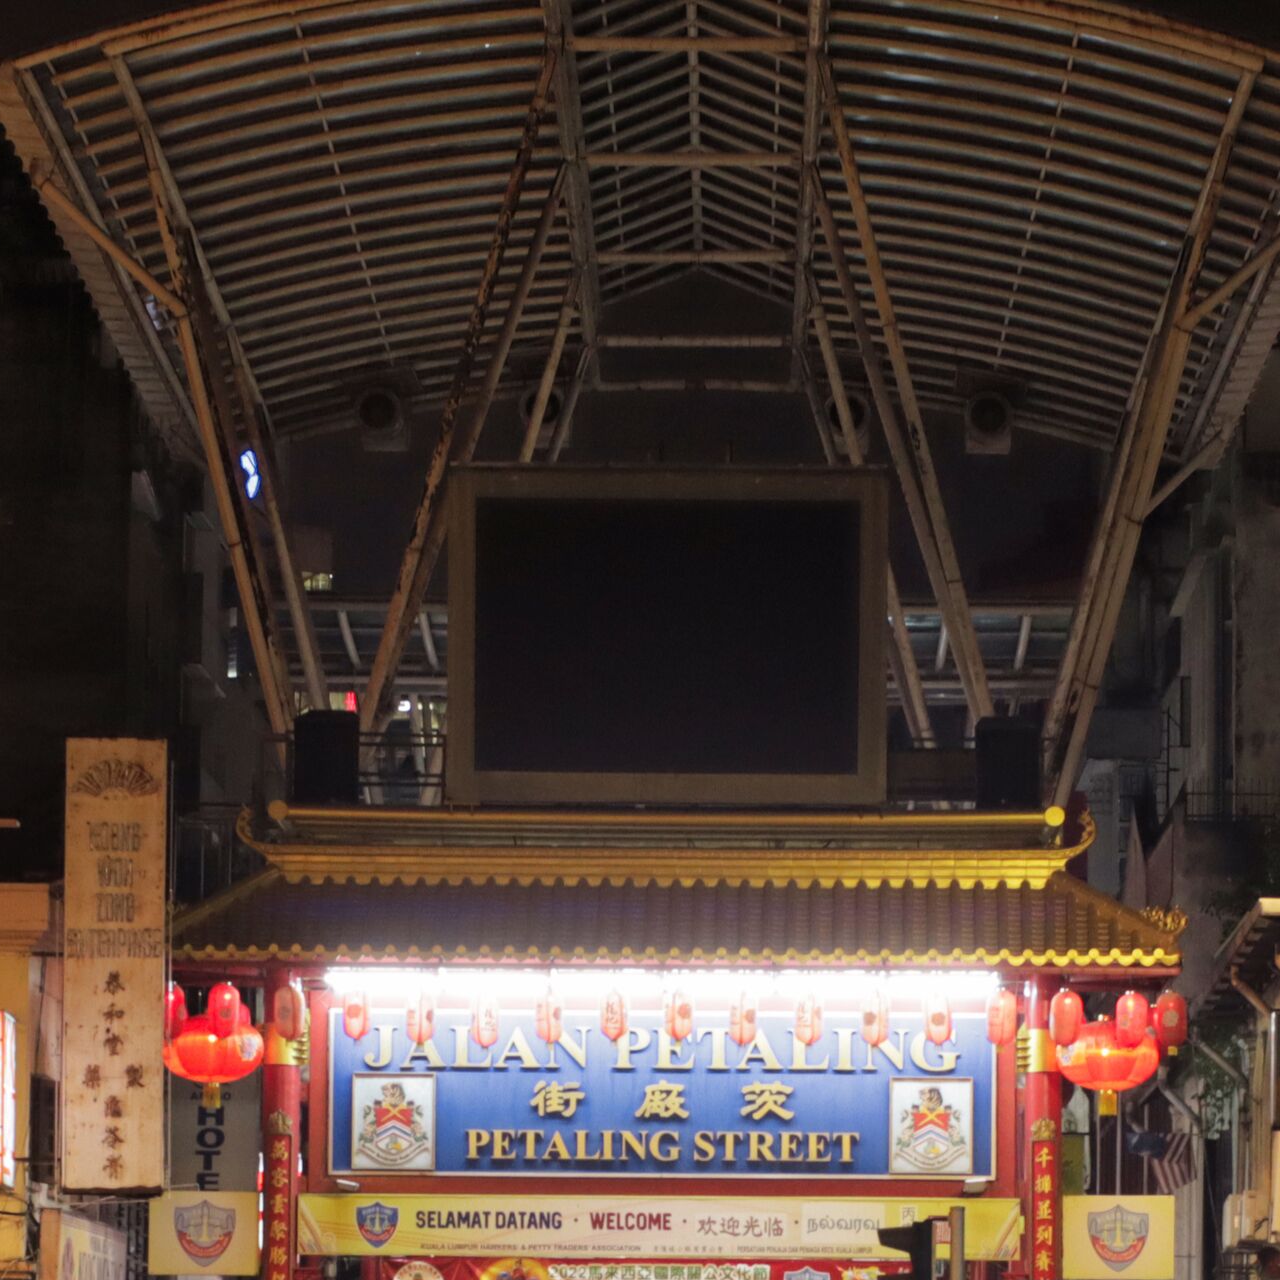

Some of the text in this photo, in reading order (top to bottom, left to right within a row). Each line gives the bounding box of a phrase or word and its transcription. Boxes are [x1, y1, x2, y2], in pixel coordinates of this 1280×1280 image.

[363, 1024, 962, 1073] JALAN PETALING
[465, 1129, 681, 1162] PETALING
[693, 1130, 860, 1164] STREET
[415, 1210, 563, 1230] SELAMAT DATANG
[589, 1212, 672, 1231] WELCOME
[1035, 1147, 1054, 1280] 千攤並列賽
[696, 1215, 785, 1238] 欢迎光临
[591, 1244, 642, 1252] ASSOCIATION
